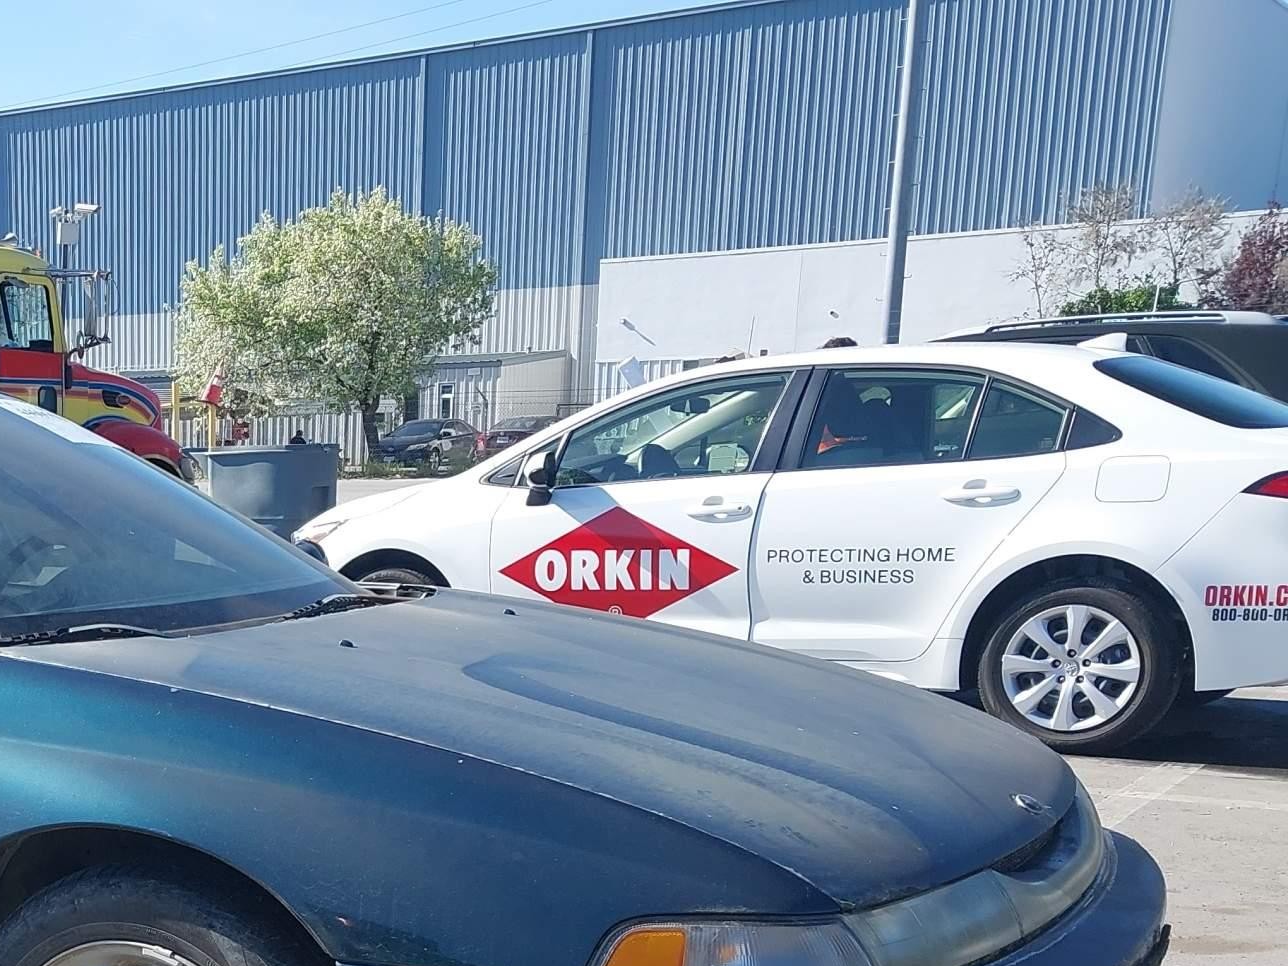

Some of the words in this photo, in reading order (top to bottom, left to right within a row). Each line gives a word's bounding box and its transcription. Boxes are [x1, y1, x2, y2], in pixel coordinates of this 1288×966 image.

[767, 548, 891, 563] PROTECTING
[896, 547, 956, 562] HOME
[533, 548, 691, 592] ORKIN
[802, 570, 815, 584] &
[820, 569, 914, 584] BUSINESS
